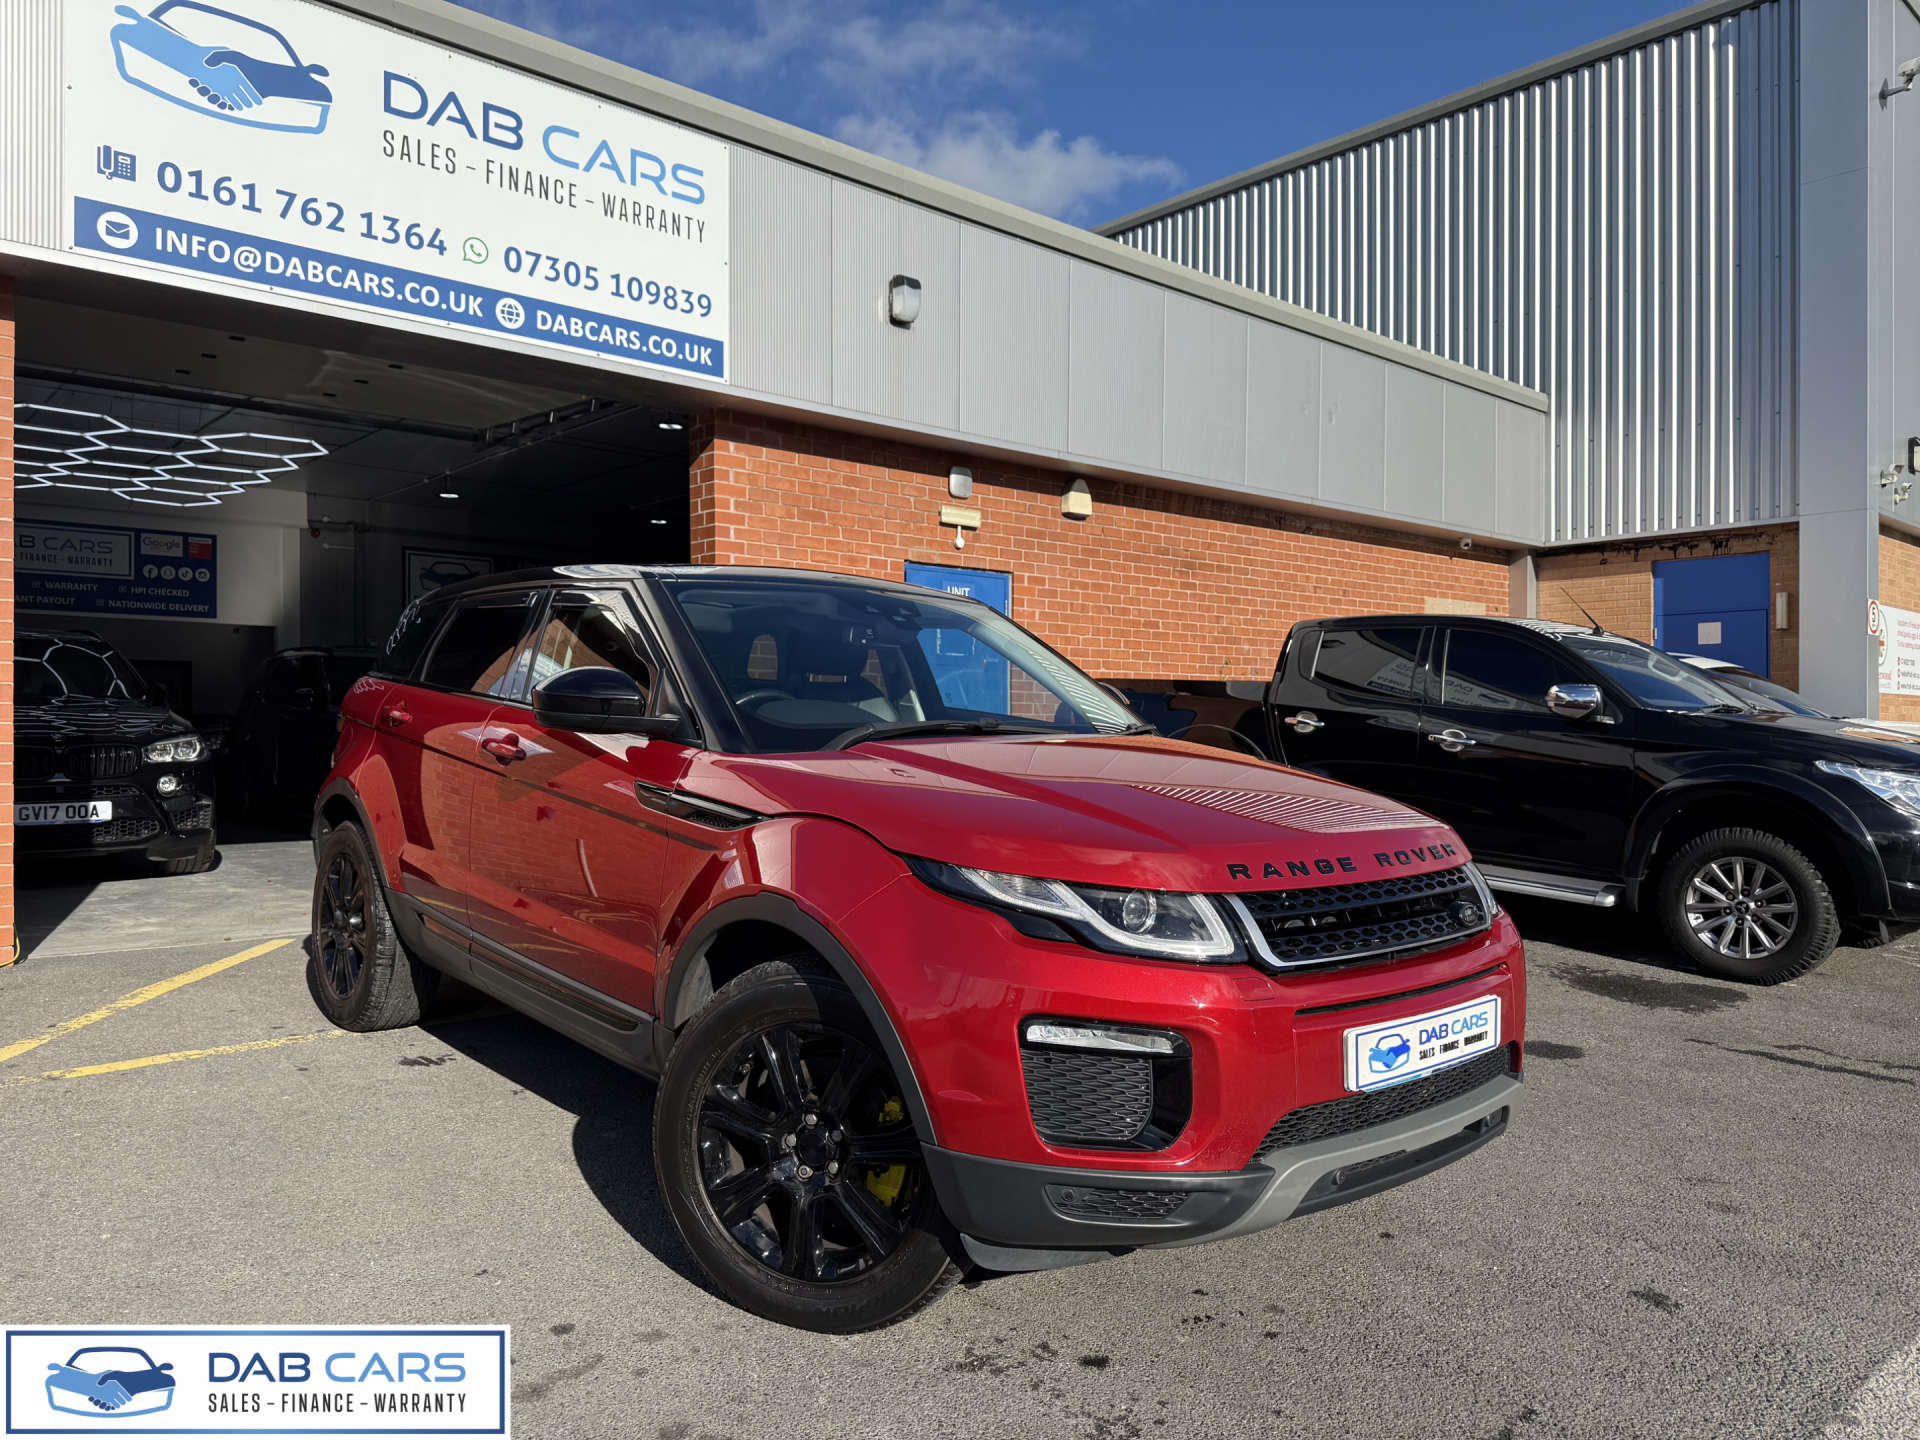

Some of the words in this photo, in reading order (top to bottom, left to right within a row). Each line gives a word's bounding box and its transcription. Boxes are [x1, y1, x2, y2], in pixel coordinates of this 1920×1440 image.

[384, 70, 523, 150] DAB
[542, 125, 706, 205] CARS
[383, 129, 456, 174] SALES
[486, 159, 577, 208] FINANCE
[602, 191, 705, 243] WARRANTY
[157, 161, 262, 214] 0161
[276, 189, 345, 233] 762
[360, 211, 447, 256] 1364
[155, 227, 483, 317] INFO@DABCARS.CO.UK
[504, 246, 599, 291] 07305
[610, 273, 712, 318] 109839
[537, 309, 712, 367] DABCARS.CO.UK
[43, 537, 113, 554] CARS
[143, 535, 180, 550] Google
[45, 580, 98, 592] WARRANTY
[18, 805, 60, 821] GV17
[1227, 857, 1358, 880] RANGE
[1373, 842, 1458, 867] ROVER
[1419, 1023, 1449, 1045] DAB
[1451, 1011, 1488, 1035] CARS
[1419, 1047, 1435, 1060] SALES
